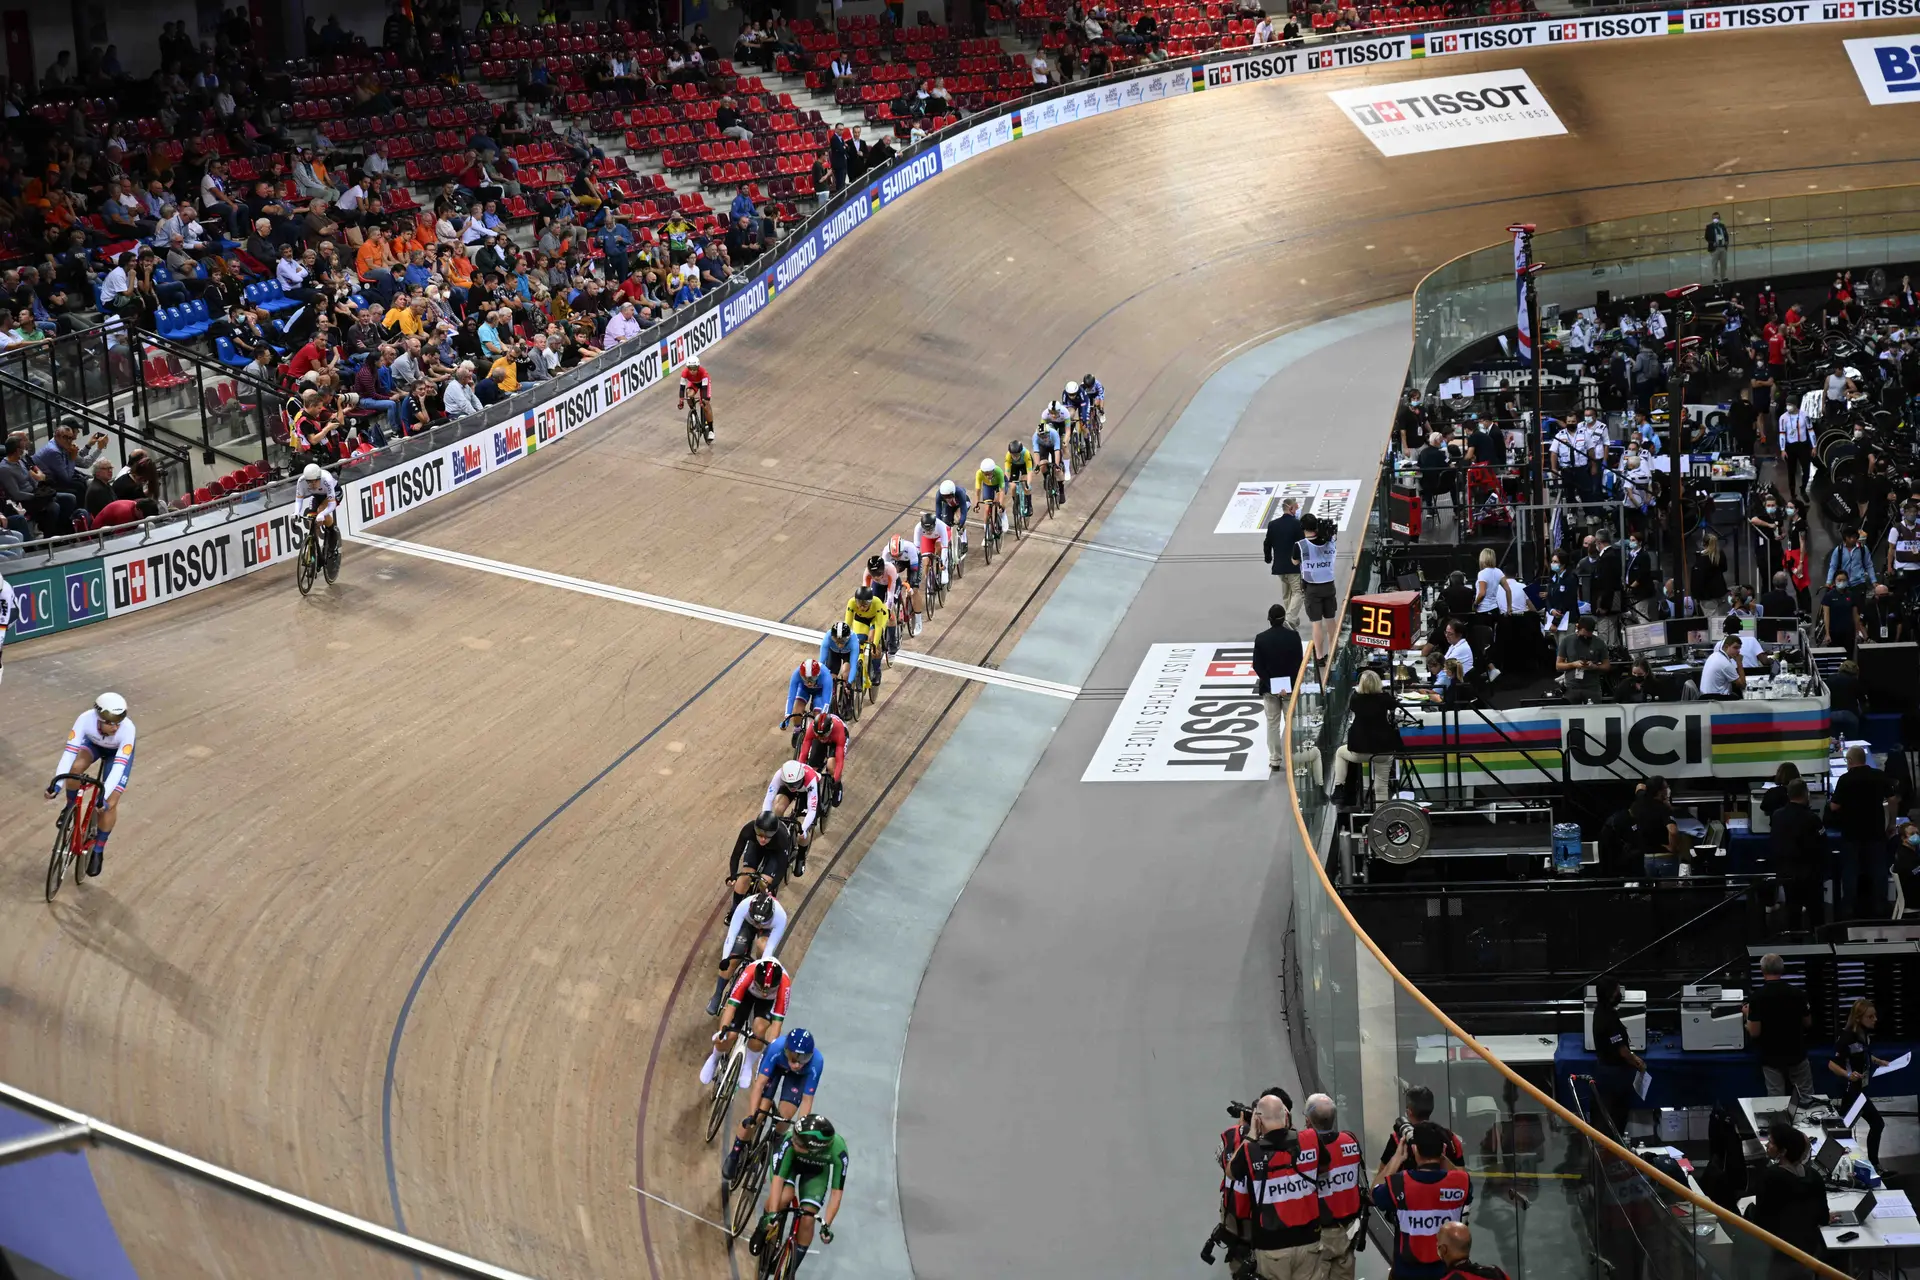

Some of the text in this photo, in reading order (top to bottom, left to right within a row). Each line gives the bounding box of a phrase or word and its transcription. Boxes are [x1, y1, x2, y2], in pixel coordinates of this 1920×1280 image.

[1723, 5, 1810, 27] TISSOT
[1857, 0, 1920, 17] TISS
[1459, 27, 1537, 50] TISSOT
[1579, 16, 1662, 38] TISSOT
[1232, 54, 1298, 82] TISSOT
[1334, 40, 1406, 65] TISSOT
[1399, 84, 1530, 118] TISSOT
[1371, 108, 1549, 139] SWISS WATCHES SINCE 1853
[882, 152, 937, 203] SHIMANO
[822, 195, 868, 250] SHIMANO
[776, 236, 817, 291] SHIMANO
[724, 280, 766, 332] SHIMANO
[683, 313, 719, 358] TISSOT
[619, 350, 659, 392] TISSOT
[555, 384, 600, 430] TISSOT
[494, 426, 522, 457] BigMat
[452, 445, 482, 477] BigMat
[385, 457, 444, 511] TISSOT
[148, 534, 230, 594] TISSOT
[18, 588, 49, 624] CIC
[70, 577, 101, 612] CIC
[1361, 606, 1392, 636] 36
[1112, 648, 1196, 773] SWISS WATCHES SINCE 1853
[1166, 678, 1265, 772] TISSOT
[1568, 714, 1702, 767] UCI
[1444, 1190, 1464, 1200] UCI
